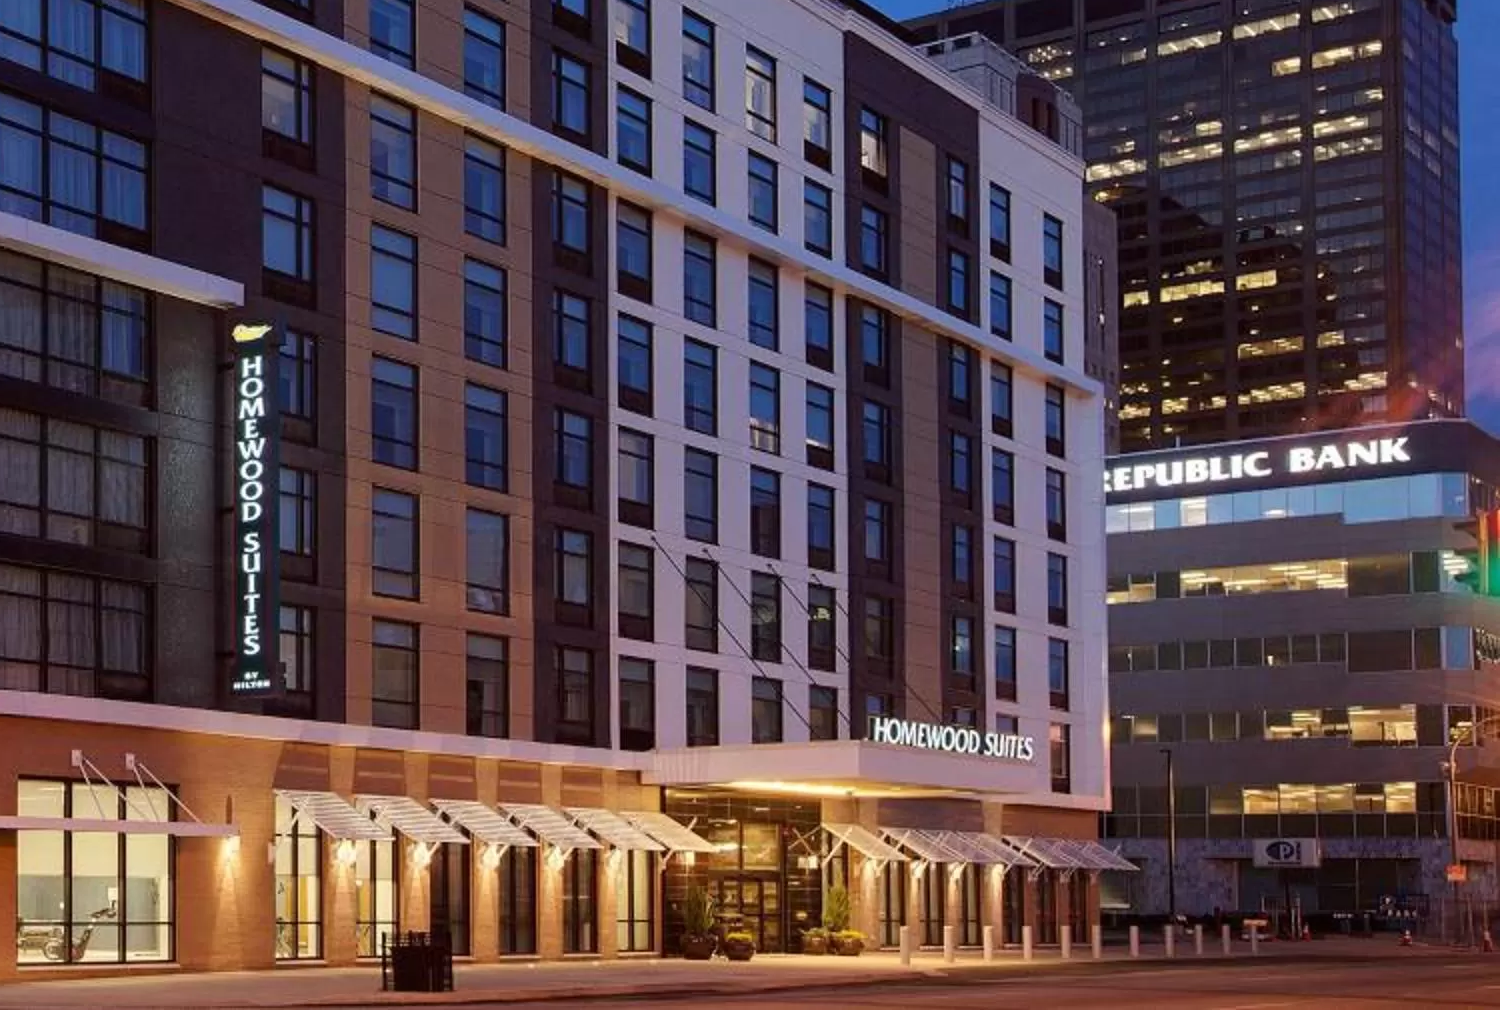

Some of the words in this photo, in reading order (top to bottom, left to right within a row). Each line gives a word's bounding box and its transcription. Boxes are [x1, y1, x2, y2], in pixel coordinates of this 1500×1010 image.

[238, 355, 266, 522] HOMEWOOD
[1289, 436, 1410, 473] BANK
[242, 532, 261, 655] SUITES
[874, 717, 979, 753] HOMEWOOD
[983, 733, 1033, 760] SUITES
